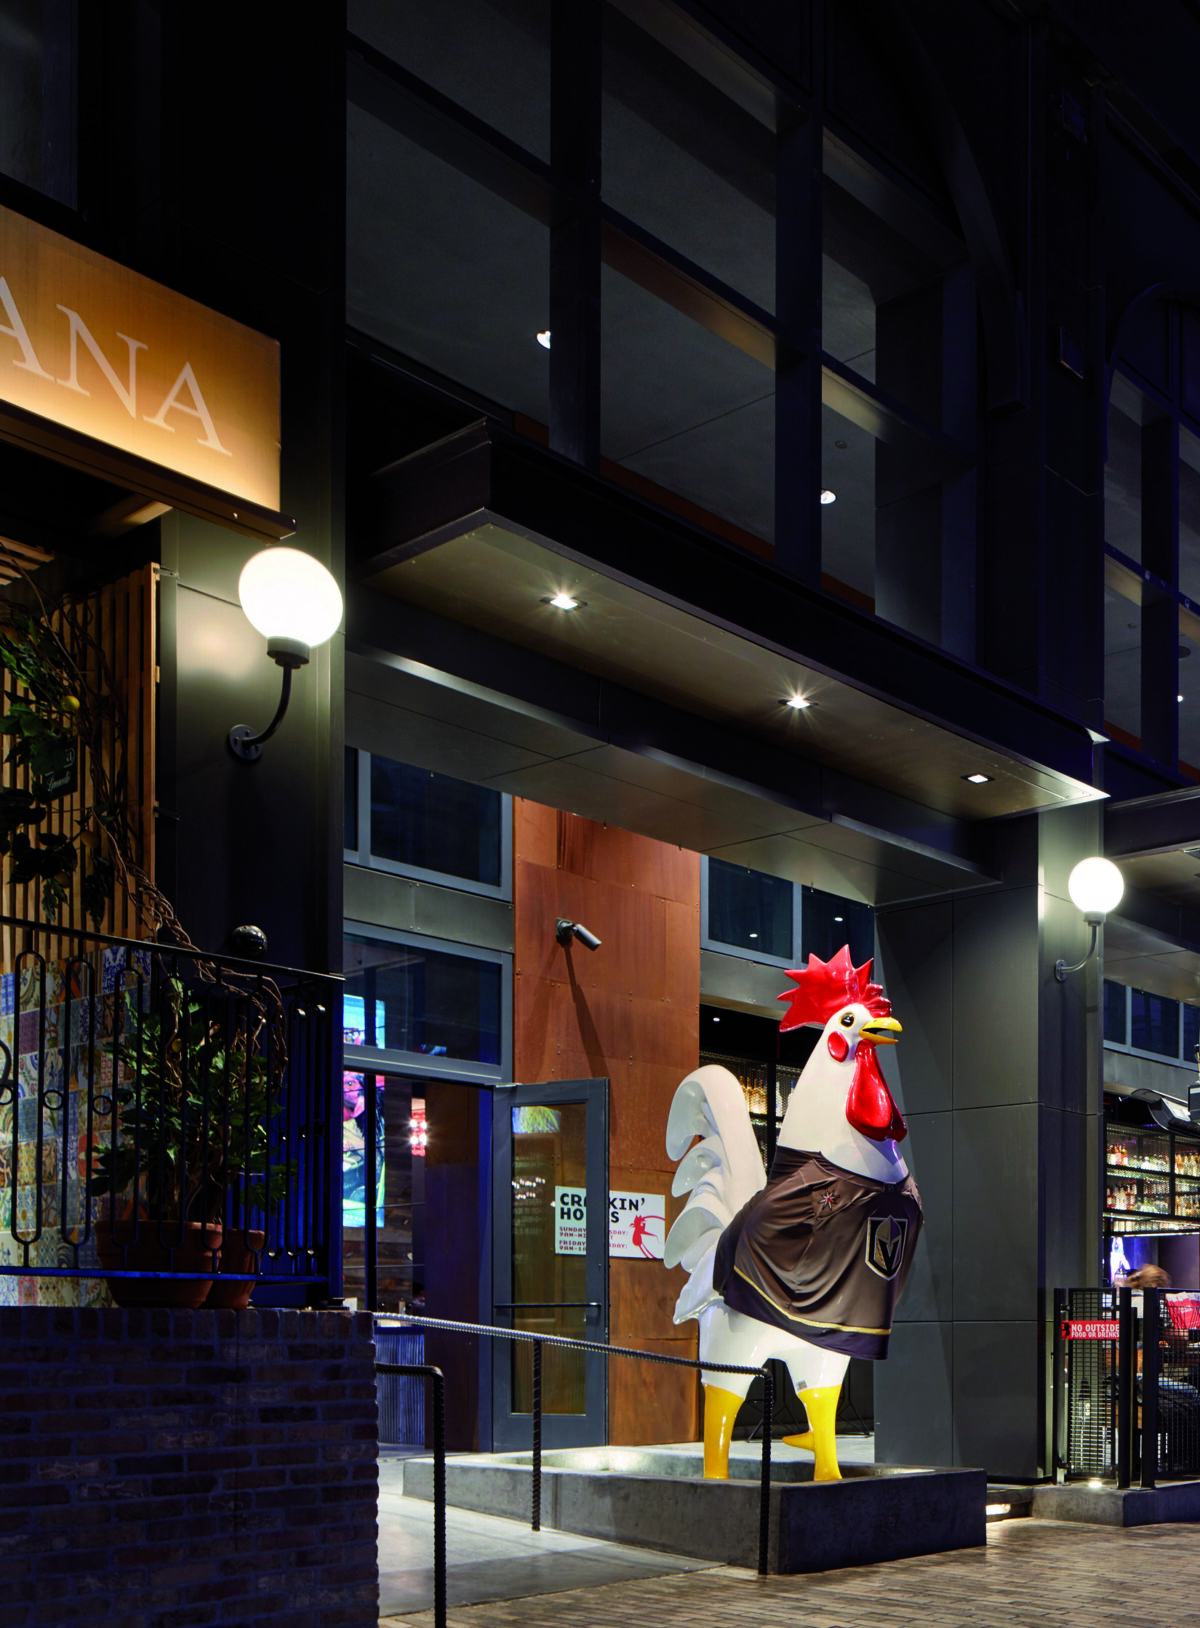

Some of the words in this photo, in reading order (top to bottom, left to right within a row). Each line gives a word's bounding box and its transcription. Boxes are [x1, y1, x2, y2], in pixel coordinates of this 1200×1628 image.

[560, 1193, 645, 1211] CRKIN'
[560, 1208, 619, 1223] HOS
[1071, 1324, 1083, 1332] NO
[1085, 1324, 1120, 1332] OUTSIDE
